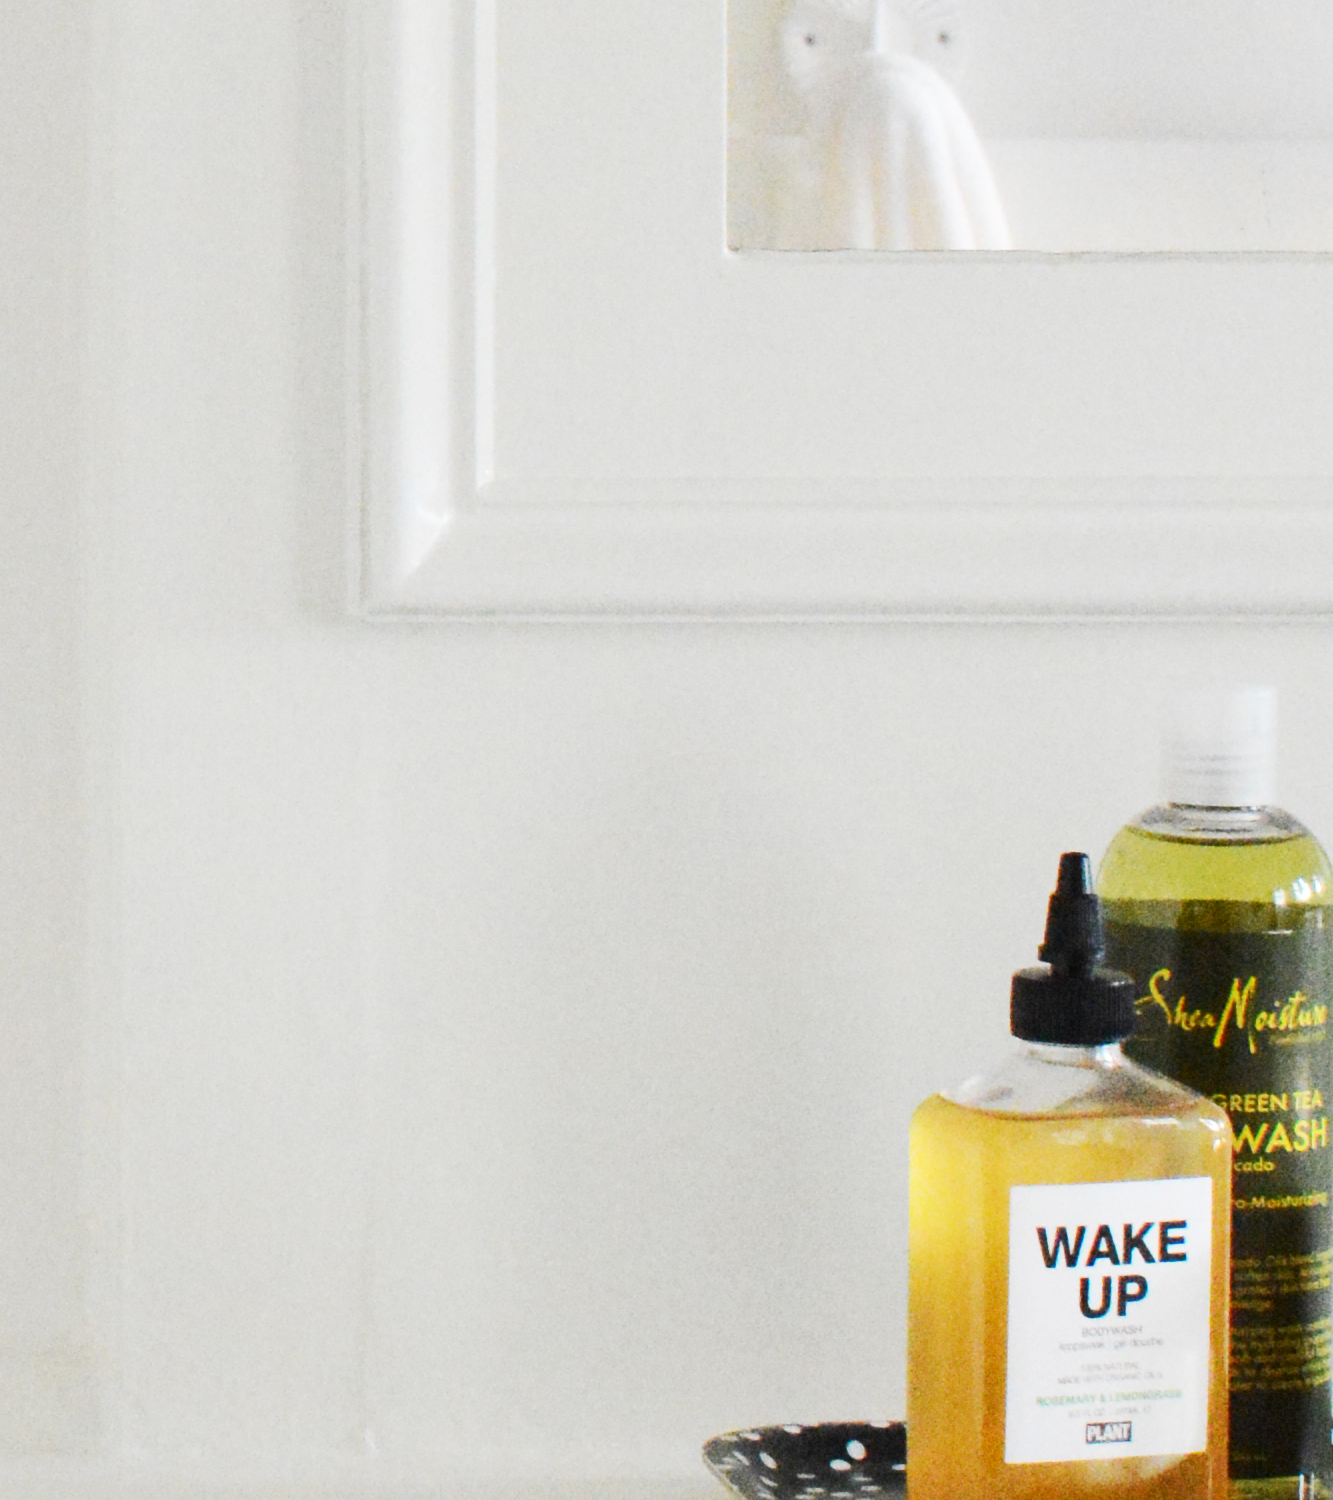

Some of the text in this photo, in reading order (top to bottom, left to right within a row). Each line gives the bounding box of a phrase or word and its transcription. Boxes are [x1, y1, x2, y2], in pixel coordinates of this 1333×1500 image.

[1293, 1089, 1324, 1111] TEA
[1231, 1117, 1329, 1154] WASH
[1036, 1219, 1187, 1268] WAKE
[1079, 1274, 1148, 1318] UP
[1087, 1423, 1130, 1442] PLANT
